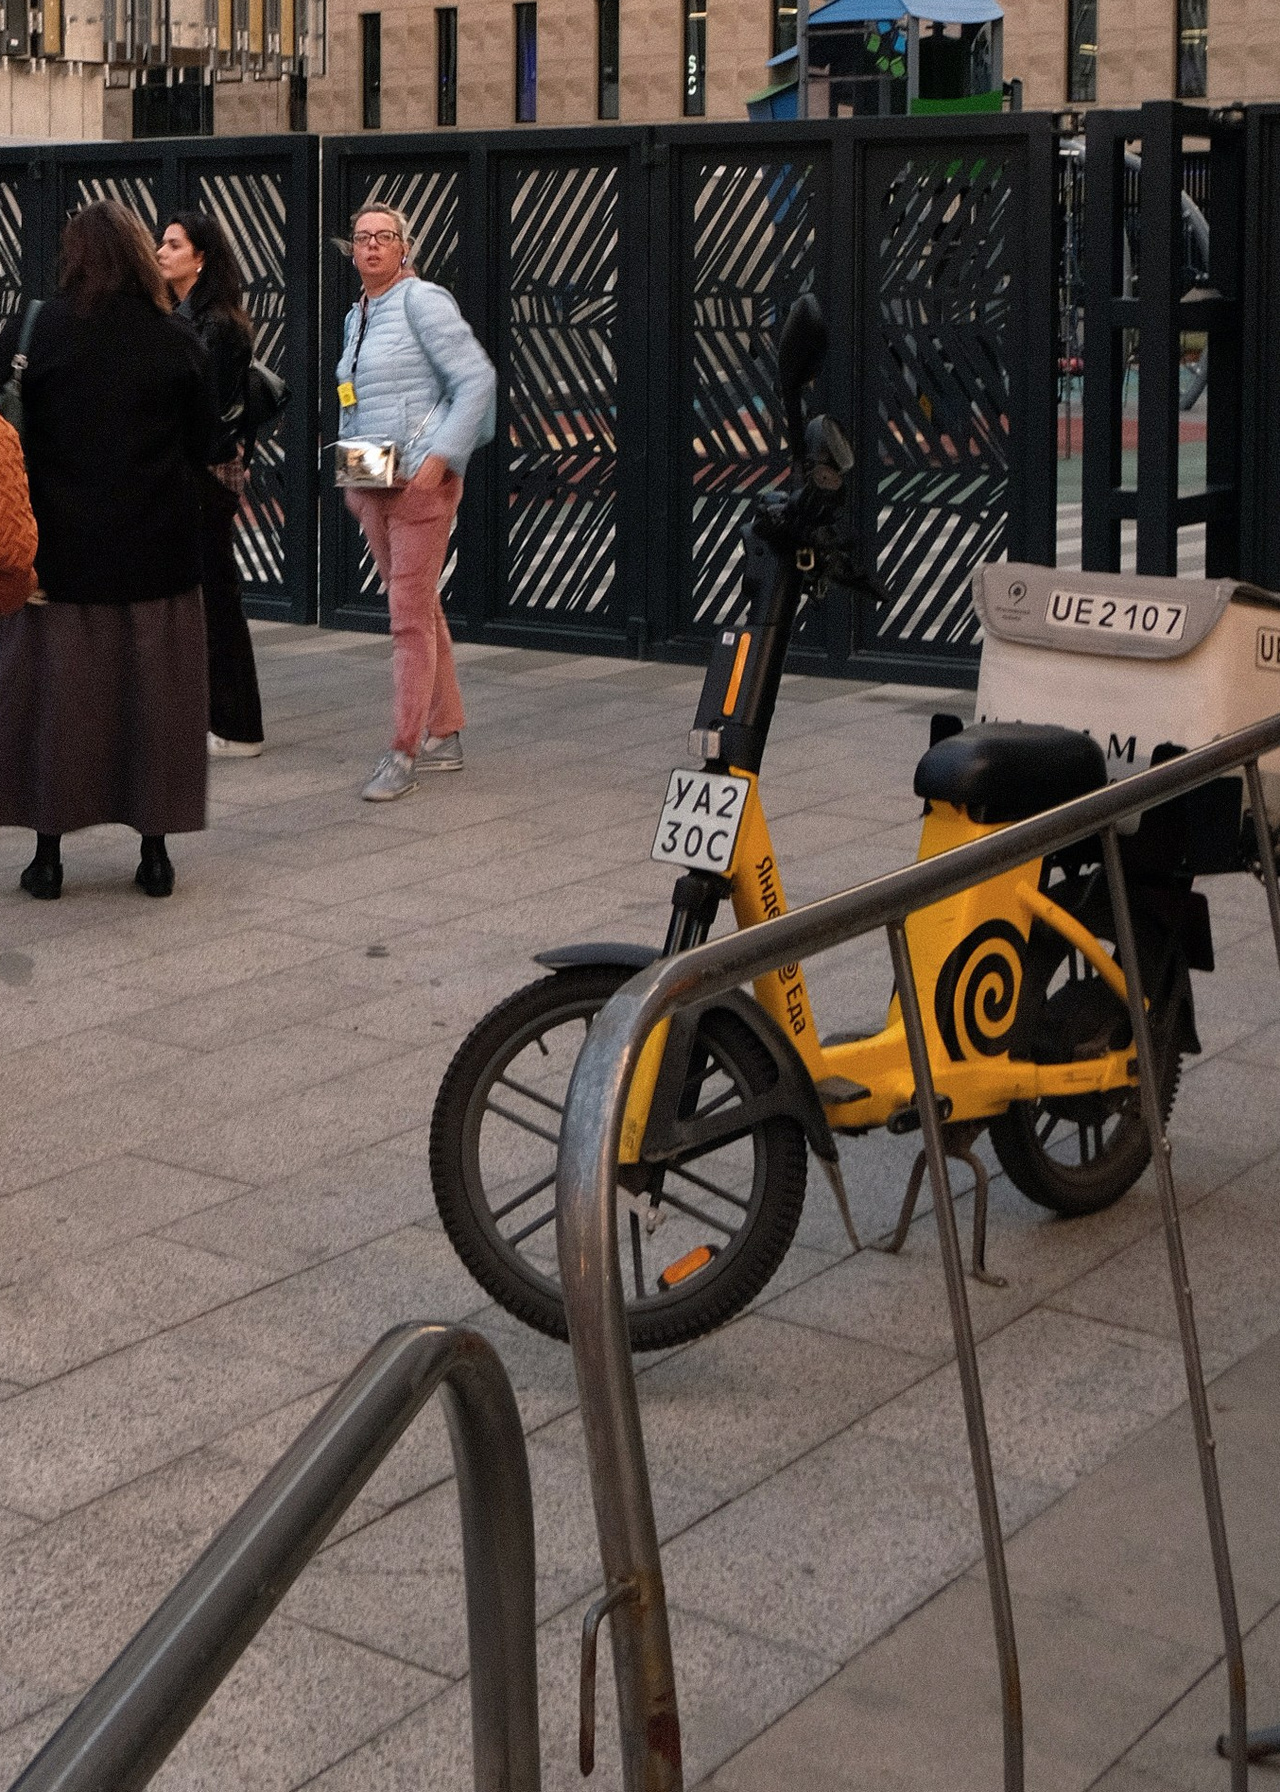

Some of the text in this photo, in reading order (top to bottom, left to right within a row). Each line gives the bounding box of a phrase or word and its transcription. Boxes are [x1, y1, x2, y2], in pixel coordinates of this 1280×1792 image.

[1051, 595, 1182, 635] UE2107
[756, 856, 807, 1036] Янде Еда
